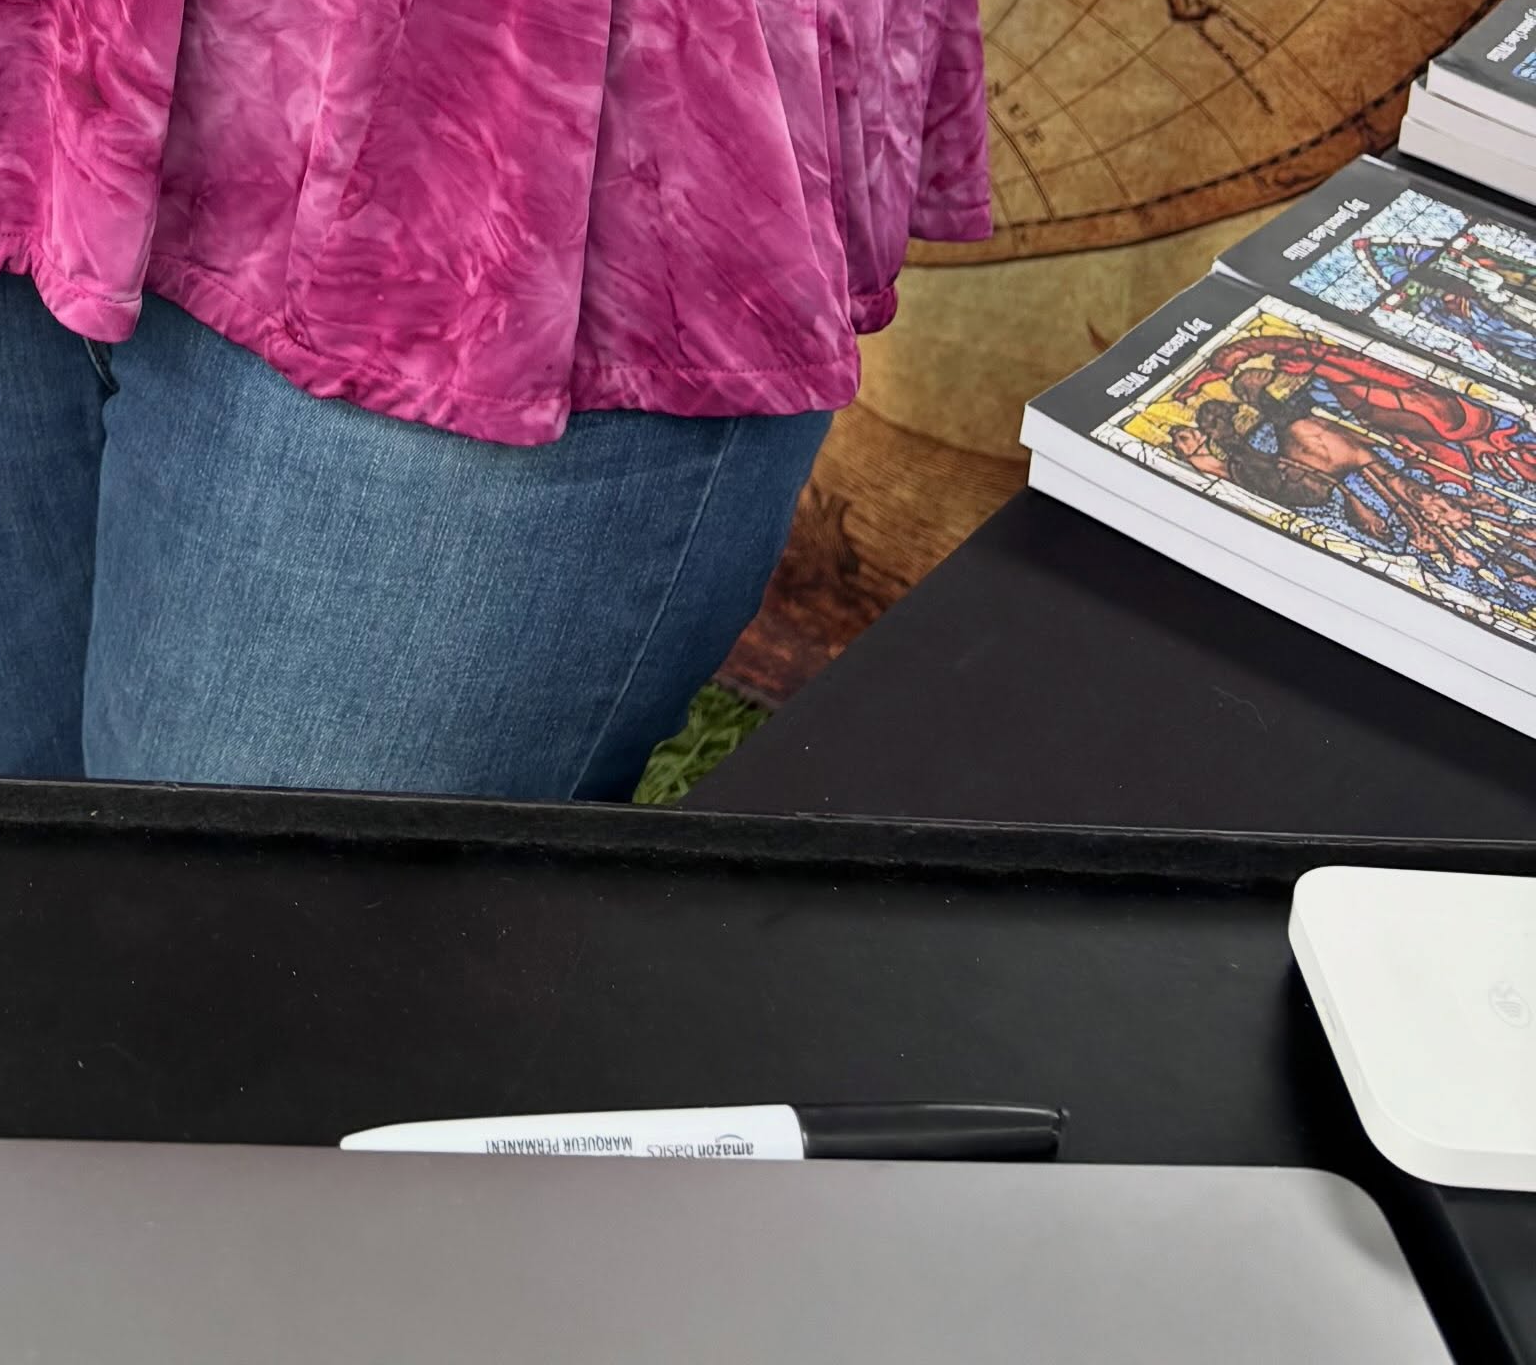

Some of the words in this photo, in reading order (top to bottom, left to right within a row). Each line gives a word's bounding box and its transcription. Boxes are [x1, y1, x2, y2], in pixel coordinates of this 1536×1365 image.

[1184, 317, 1213, 335] By
[1156, 326, 1198, 358] Jason
[1137, 353, 1170, 374] Lee
[484, 1137, 560, 1155] PERMANENT
[564, 1136, 632, 1153] MARQUEUR
[697, 1142, 754, 1159] amazon
